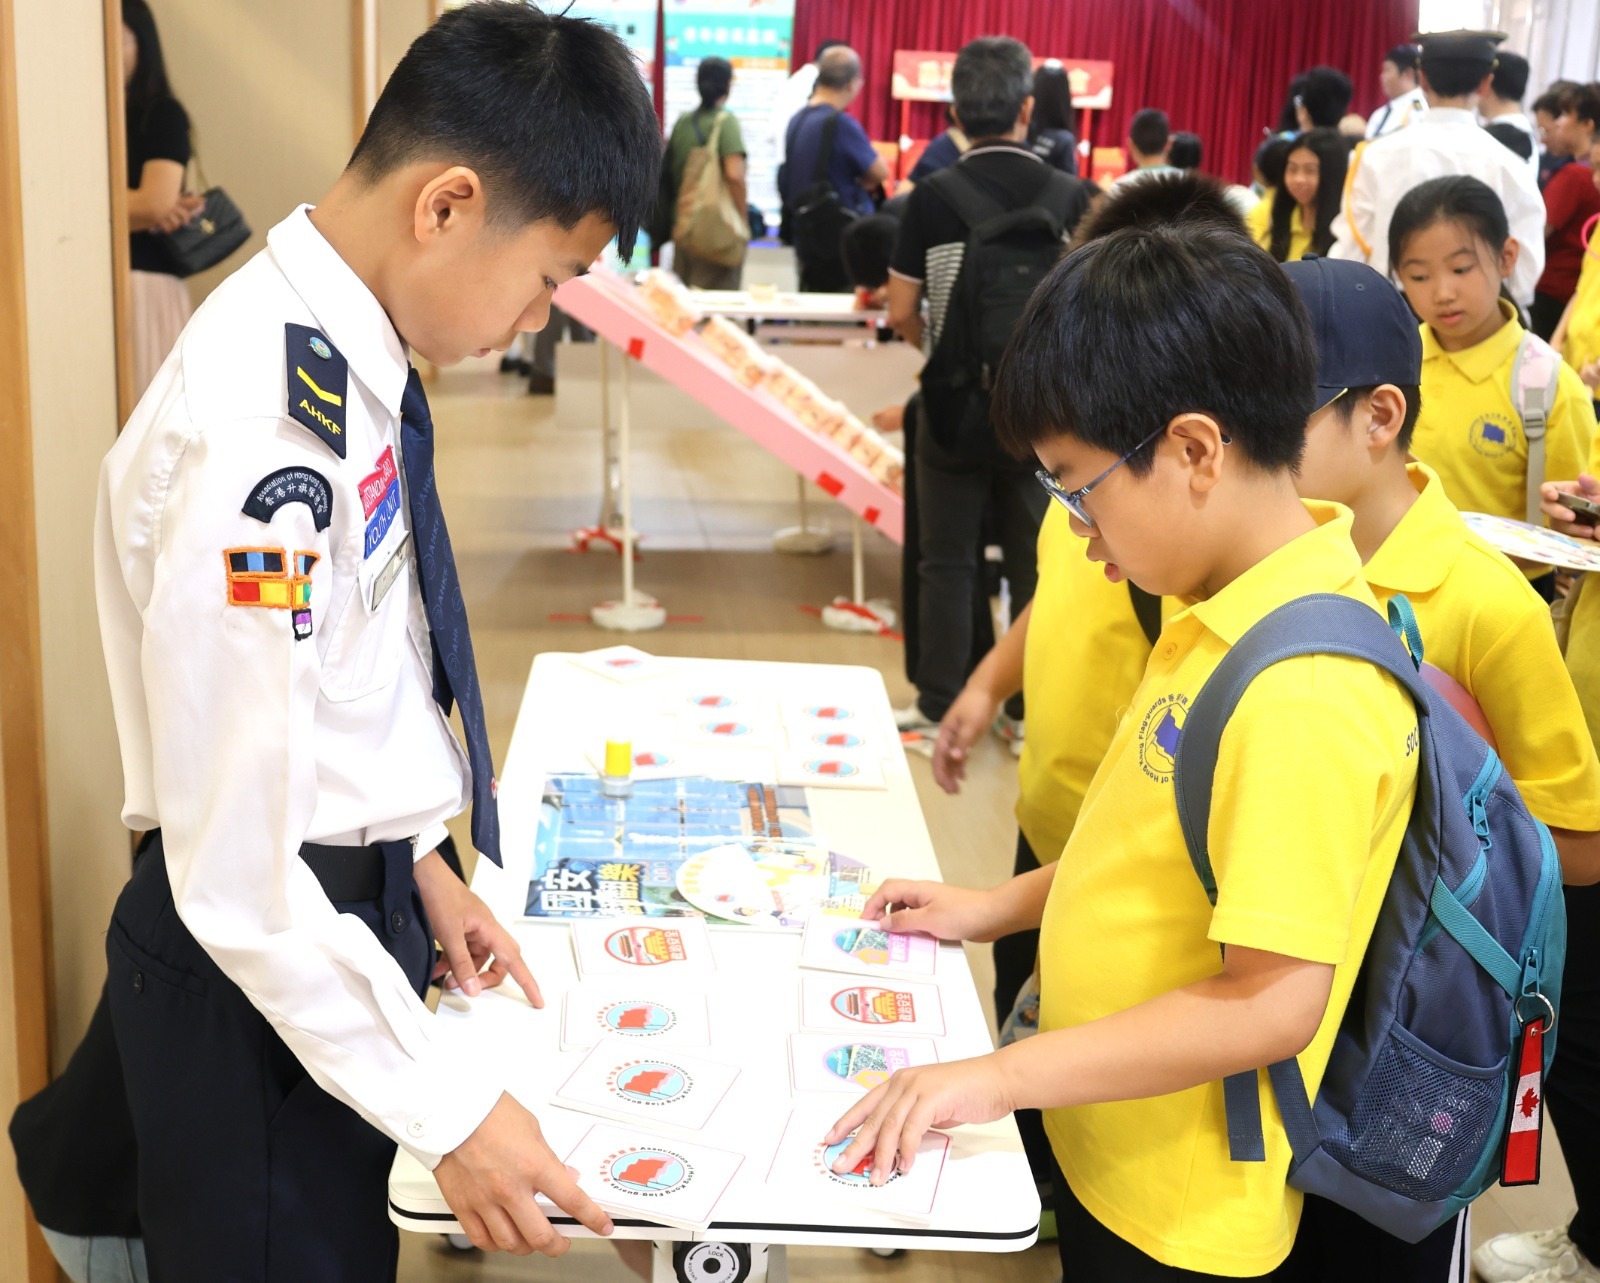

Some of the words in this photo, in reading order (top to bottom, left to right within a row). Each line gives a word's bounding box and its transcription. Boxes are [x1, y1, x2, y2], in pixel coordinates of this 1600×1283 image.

[299, 399, 341, 435] AHKF
[256, 476, 286, 502] Association
[286, 472, 294, 480] of
[294, 472, 309, 482] Hong
[1143, 765, 1159, 783] Hong
[1161, 776, 1169, 784] of
[540, 868, 593, 912] 國安
[708, 1250, 724, 1258] LOCK
